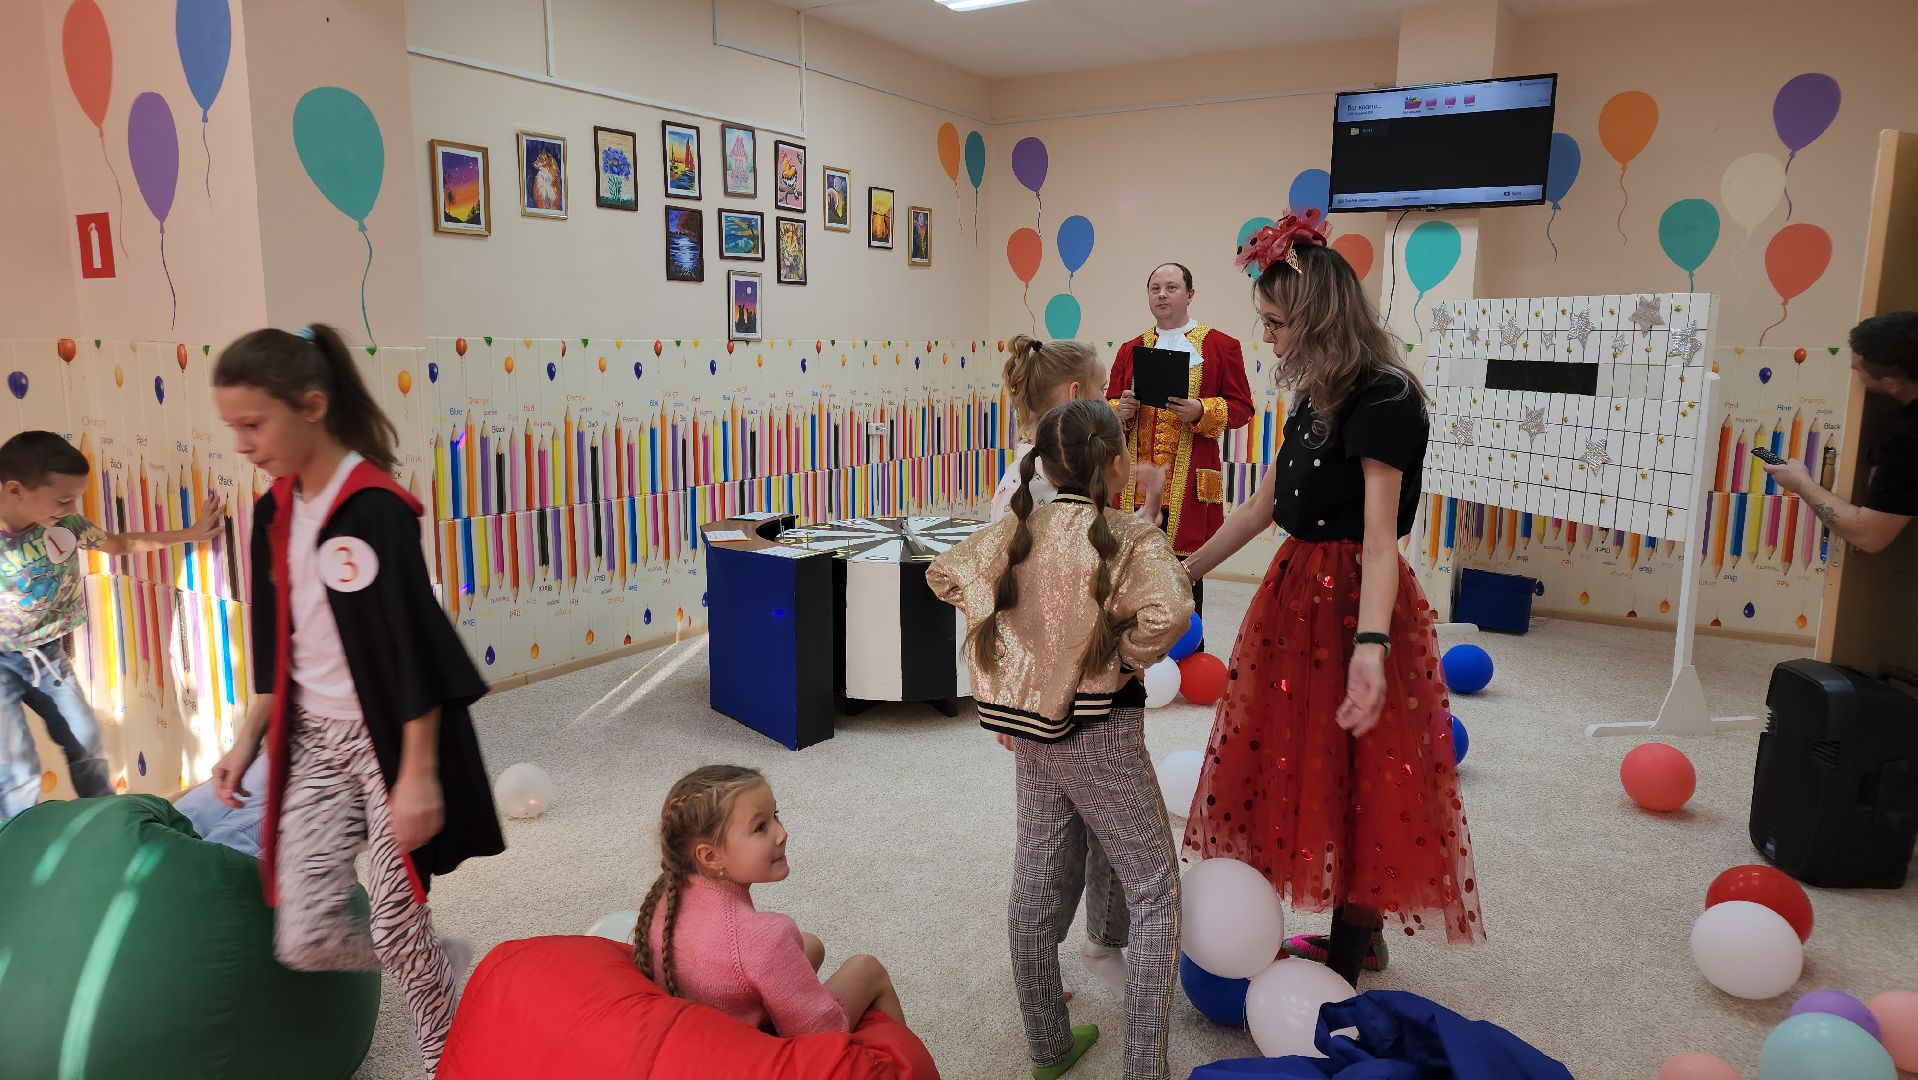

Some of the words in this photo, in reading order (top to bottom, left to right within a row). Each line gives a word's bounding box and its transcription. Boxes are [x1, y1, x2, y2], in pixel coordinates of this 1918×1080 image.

[449, 407, 463, 416] Blue
[523, 404, 535, 412] Red
[1776, 404, 1793, 412] Blue
[491, 425, 506, 434] Black
[1823, 422, 1842, 430] Black
[136, 434, 148, 447] Red
[176, 440, 188, 454] Blue
[217, 474, 234, 487] Black
[48, 534, 66, 556] 1
[332, 546, 360, 583] 3
[1723, 574, 1738, 583] Blue
[1776, 579, 1790, 588] Red
[509, 610, 521, 619] Red
[462, 618, 476, 627] Blue
